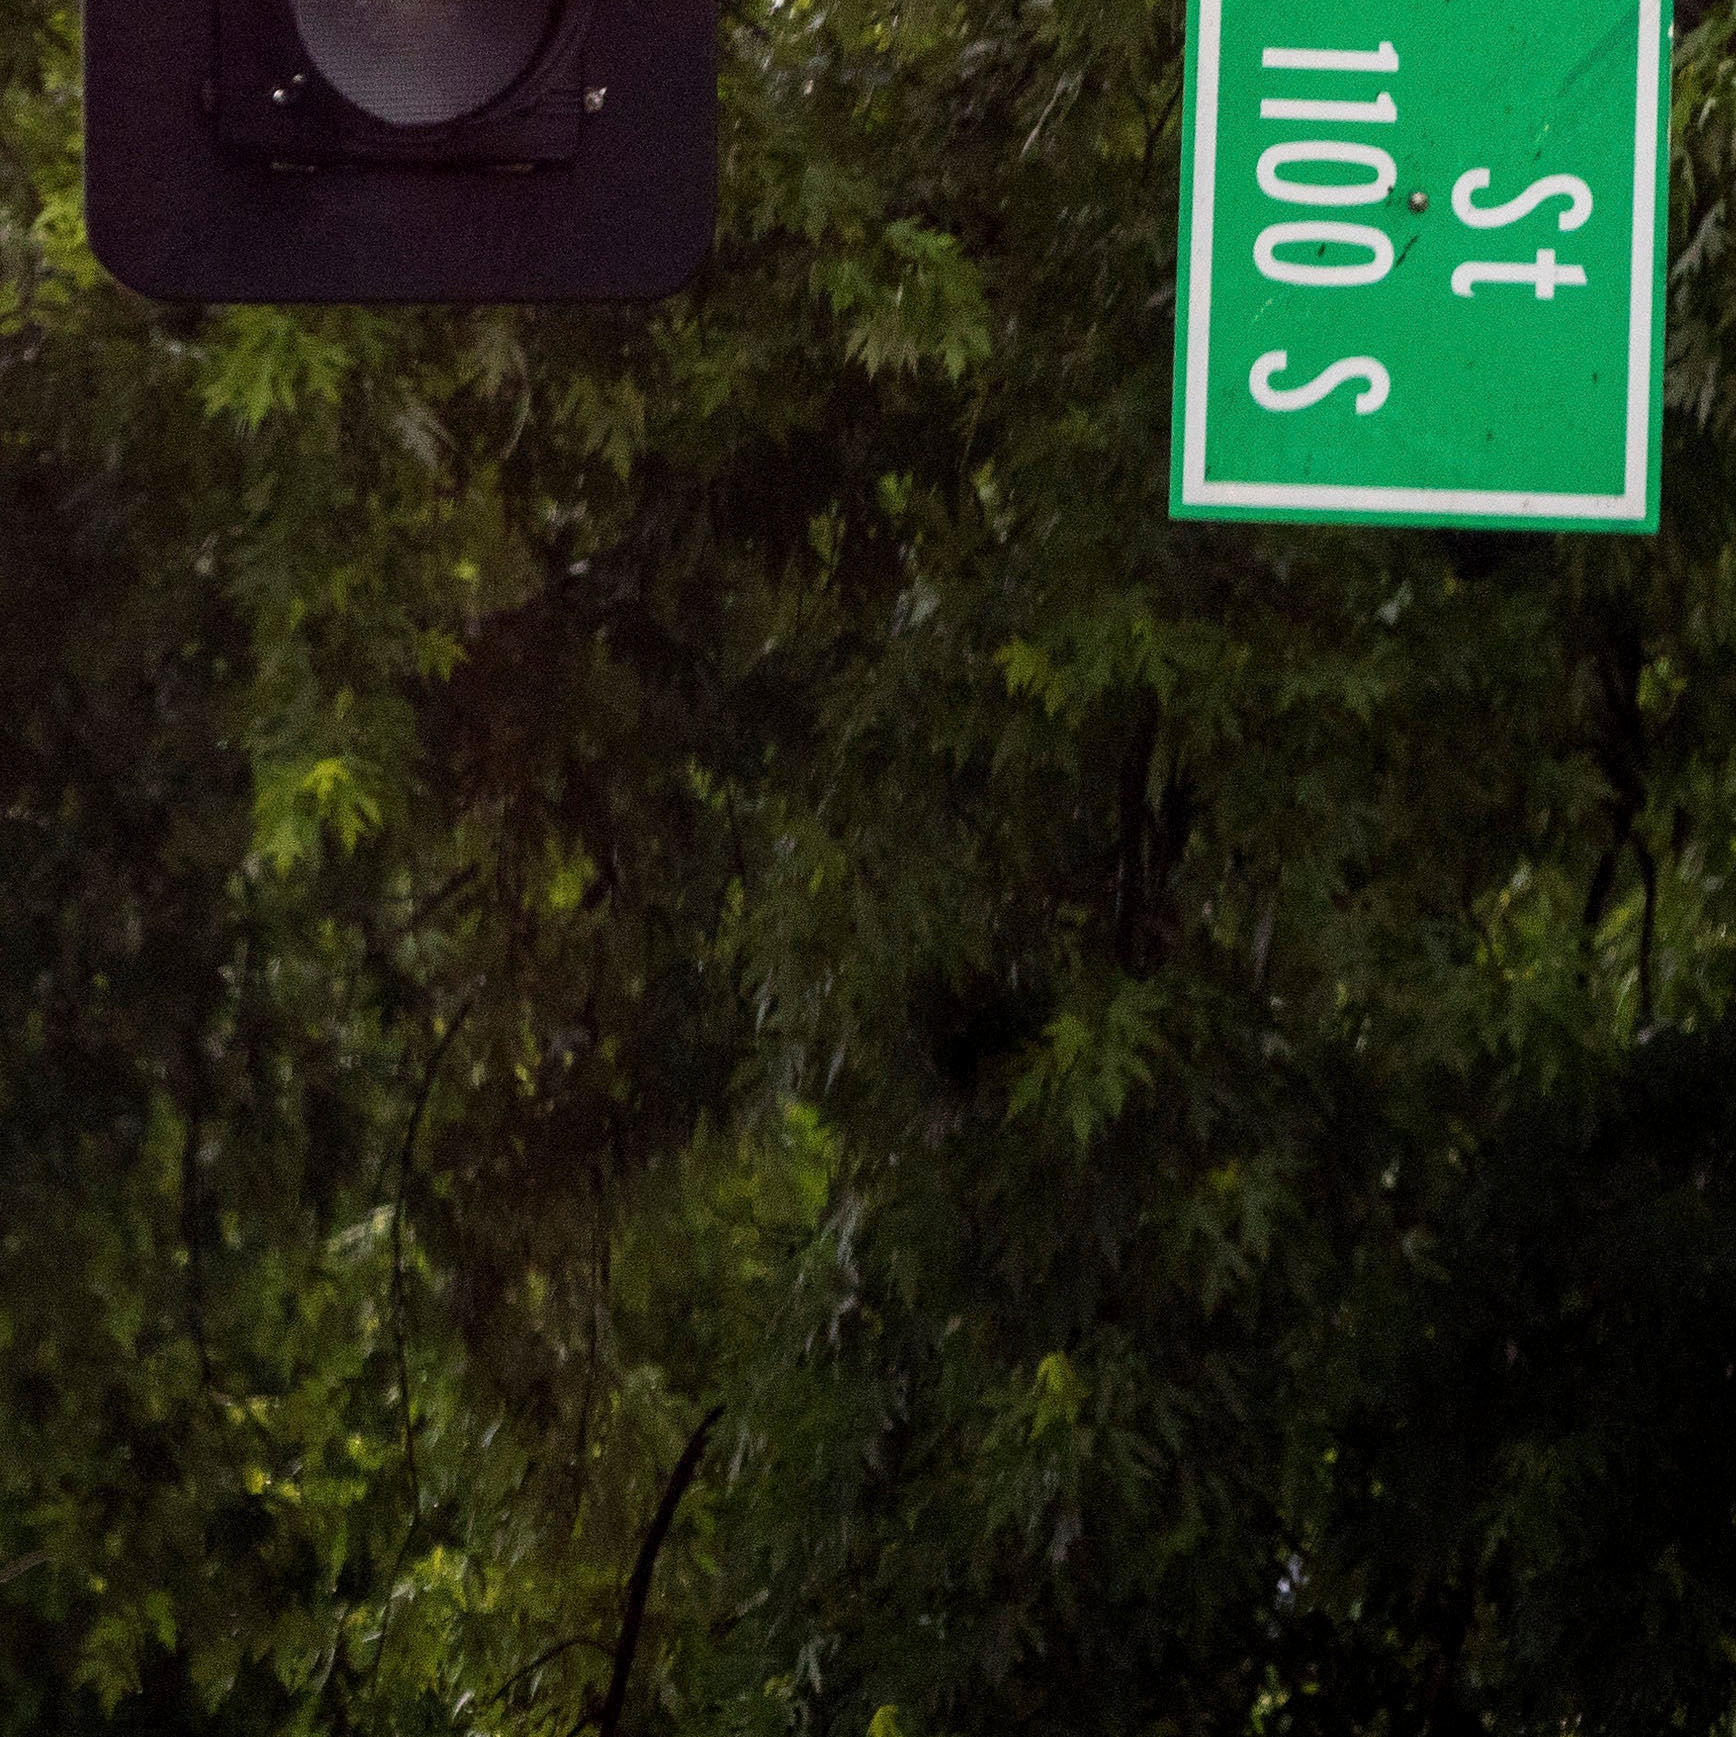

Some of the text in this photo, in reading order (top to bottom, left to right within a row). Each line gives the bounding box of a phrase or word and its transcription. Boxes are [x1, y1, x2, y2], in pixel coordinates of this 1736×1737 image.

[1248, 40, 1400, 416] 1100 S
[1450, 166, 1594, 300] St
